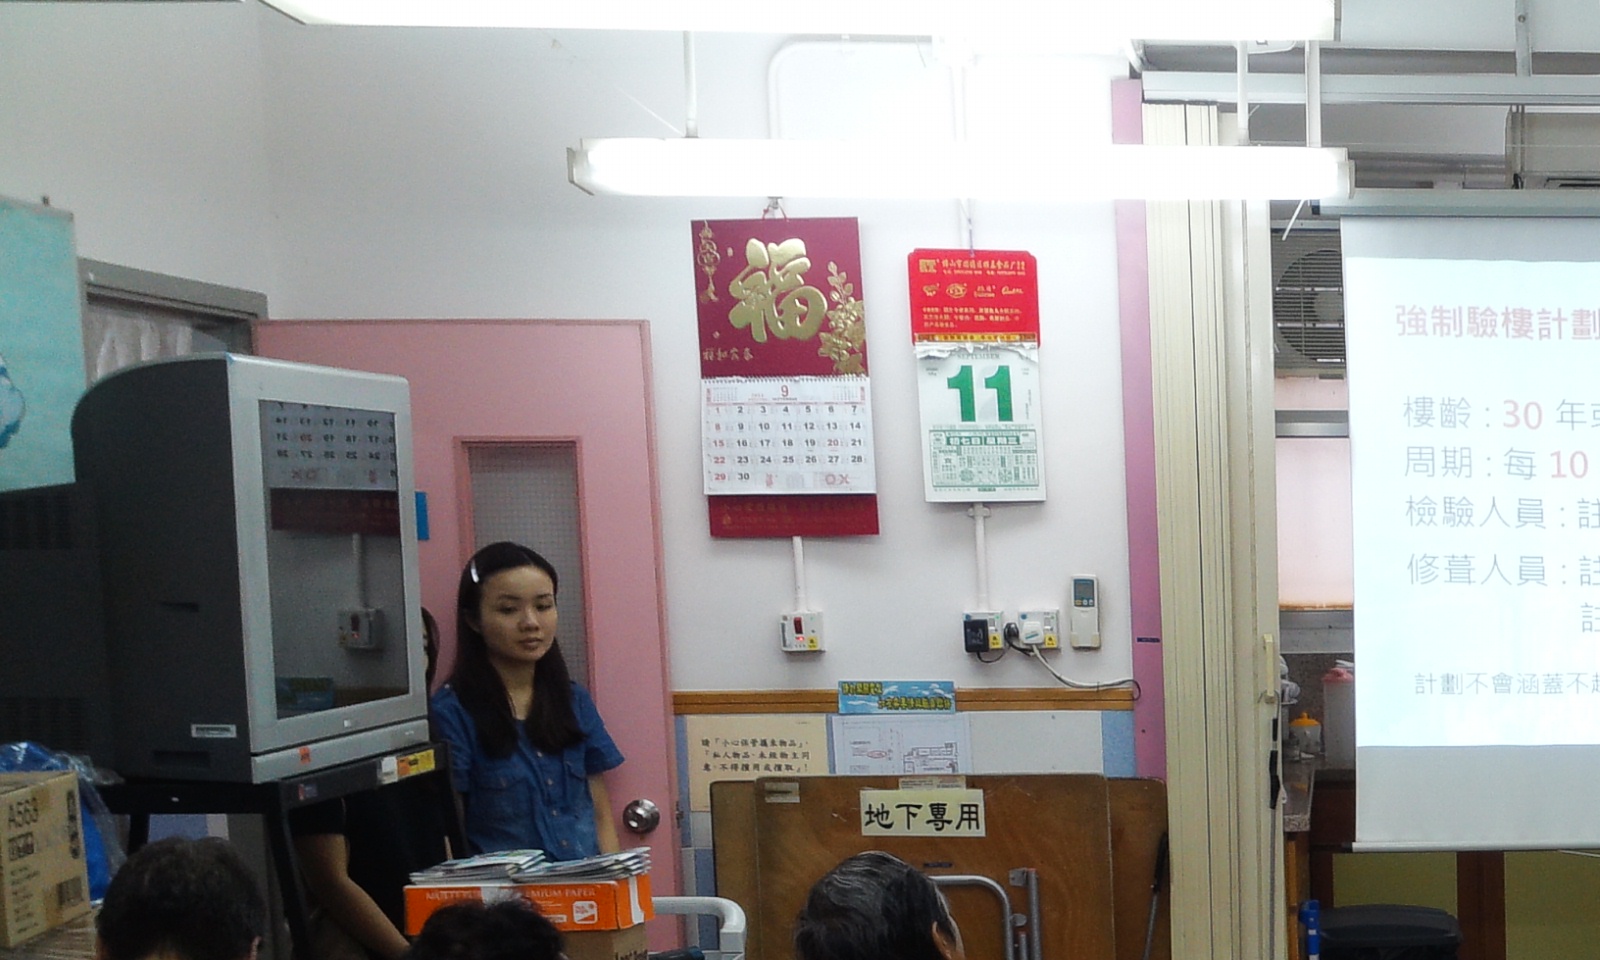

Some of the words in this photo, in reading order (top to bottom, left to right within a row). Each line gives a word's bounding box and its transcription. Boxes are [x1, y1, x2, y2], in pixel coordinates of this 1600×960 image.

[729, 238, 828, 343] 福
[781, 385, 789, 397] 9
[946, 364, 1014, 422] 11
[1503, 399, 1543, 430] 30
[1504, 447, 1537, 480] 每
[1550, 450, 1588, 479] 10
[565, 889, 596, 898] PAPER
